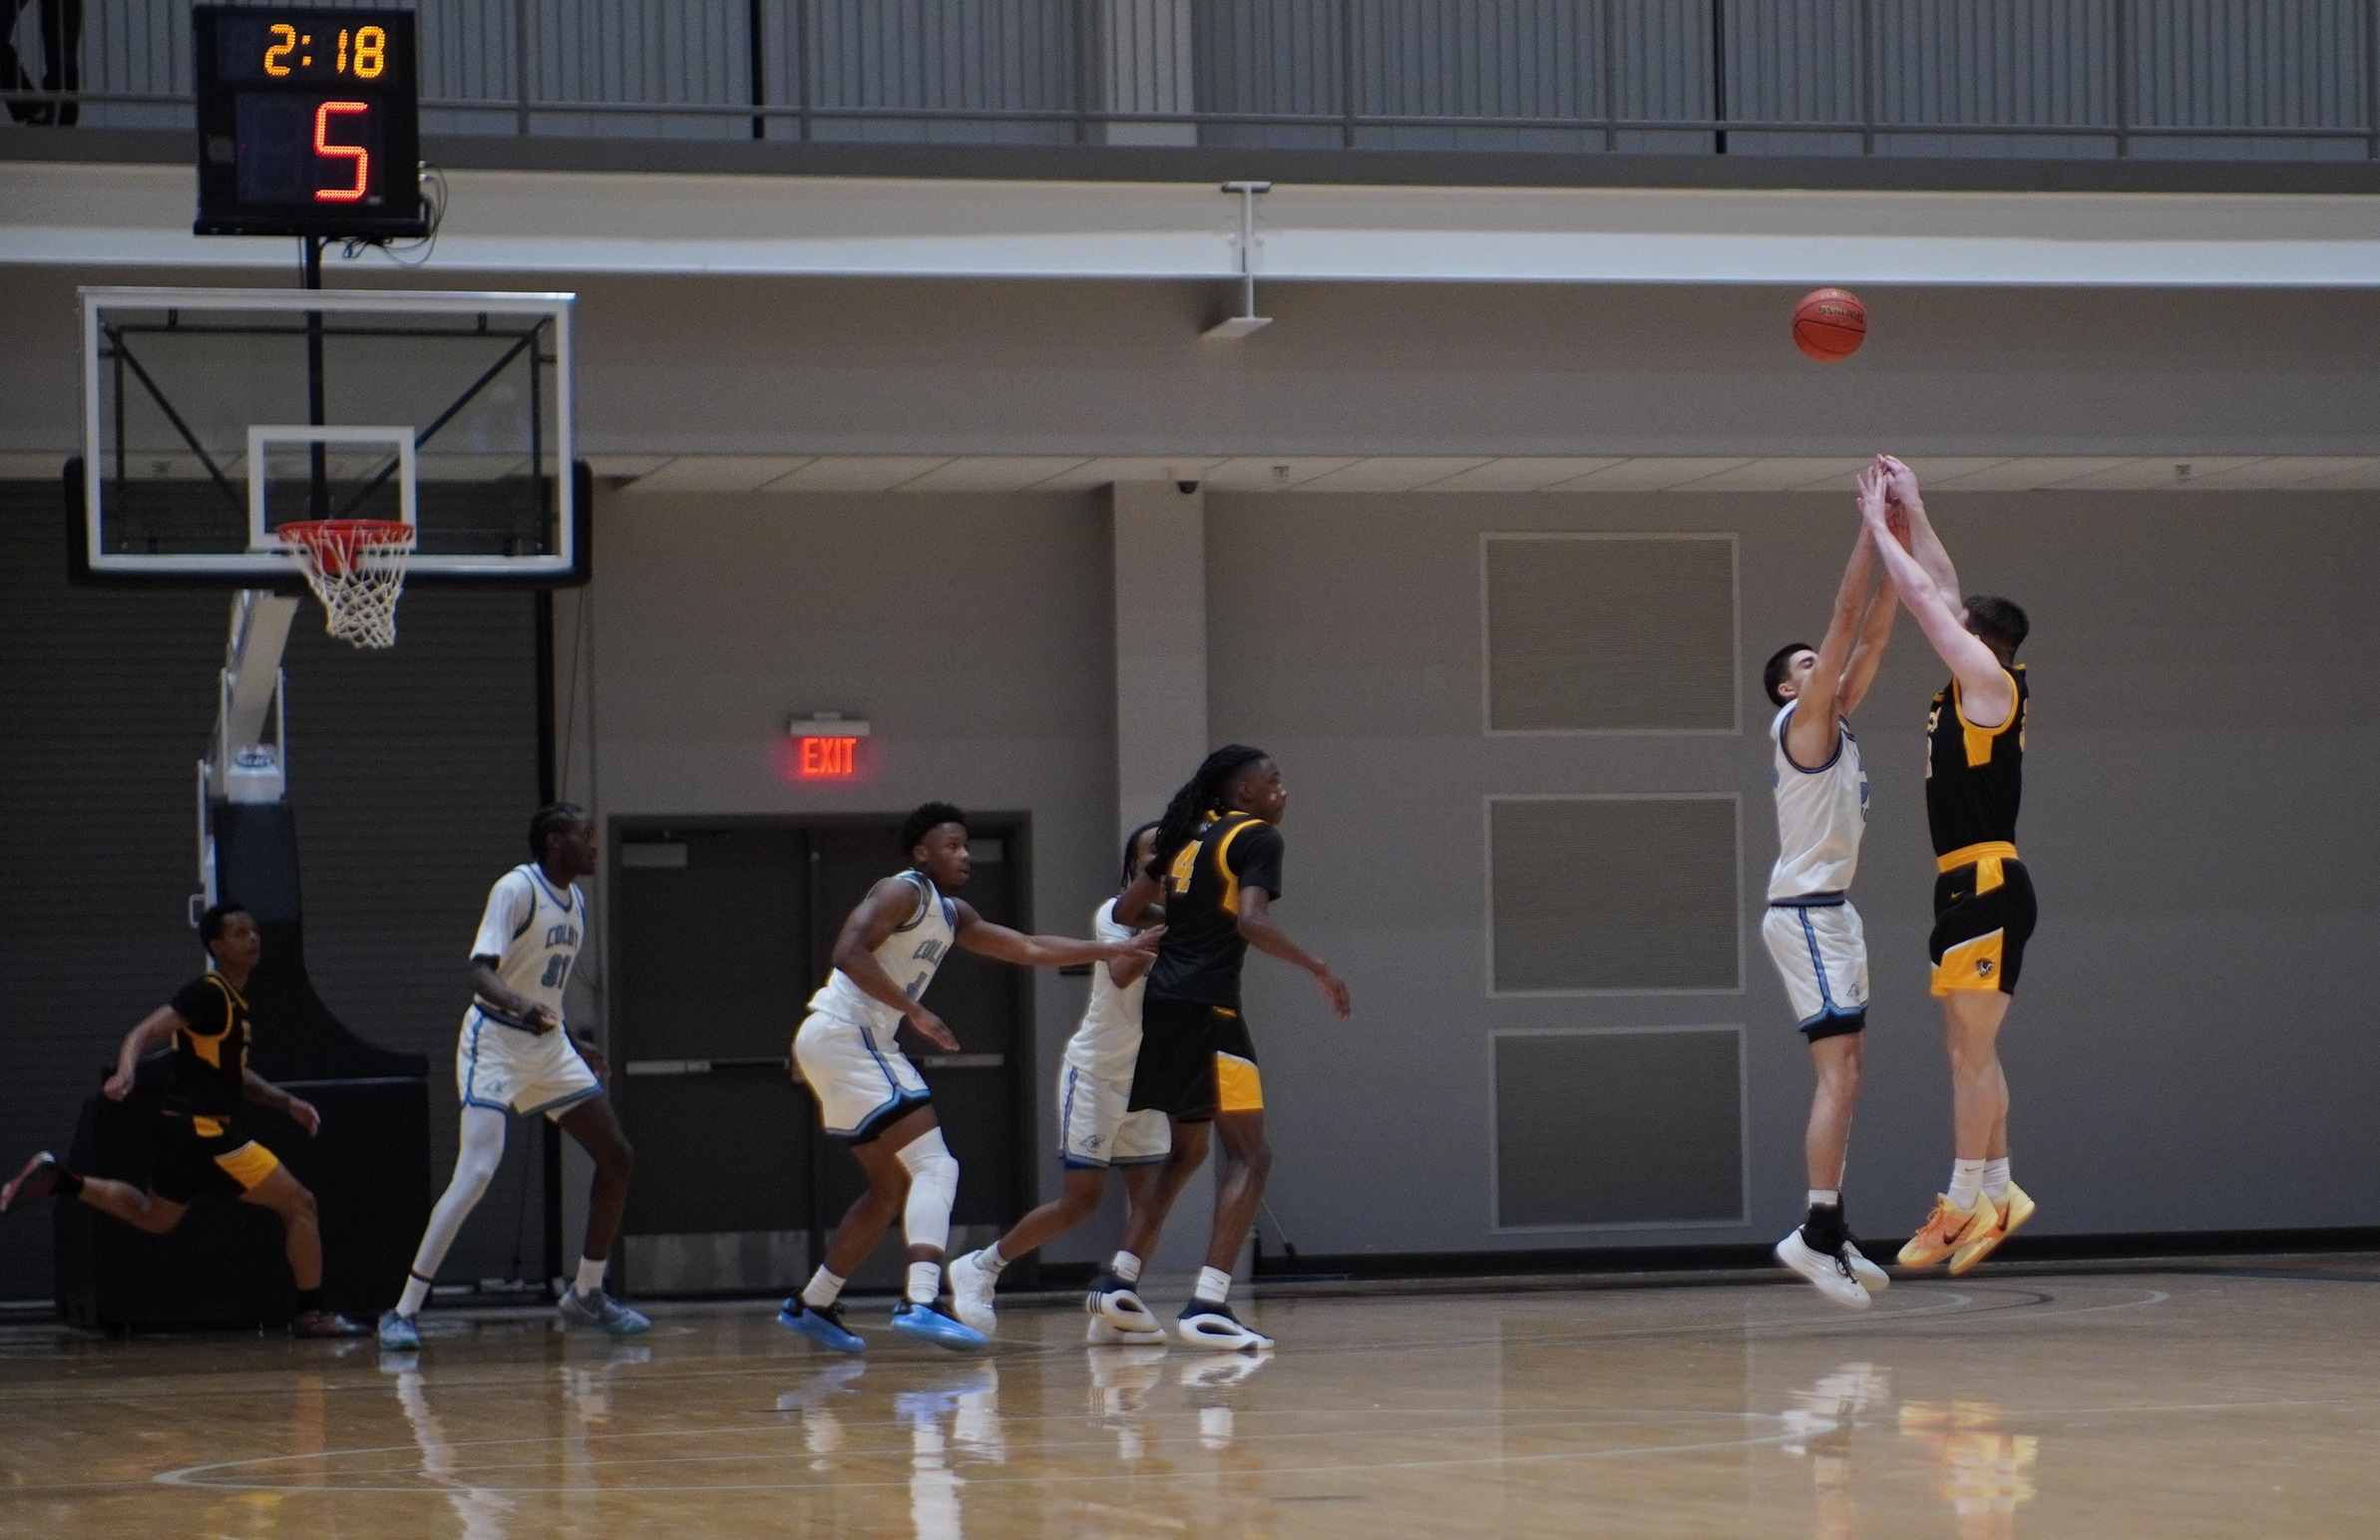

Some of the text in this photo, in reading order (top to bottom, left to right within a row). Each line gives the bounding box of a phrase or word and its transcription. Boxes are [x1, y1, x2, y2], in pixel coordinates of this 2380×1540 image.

[263, 24, 386, 79] 2:18
[314, 101, 368, 201] 5
[803, 738, 857, 773] EXIT
[1171, 839, 1203, 894] 4
